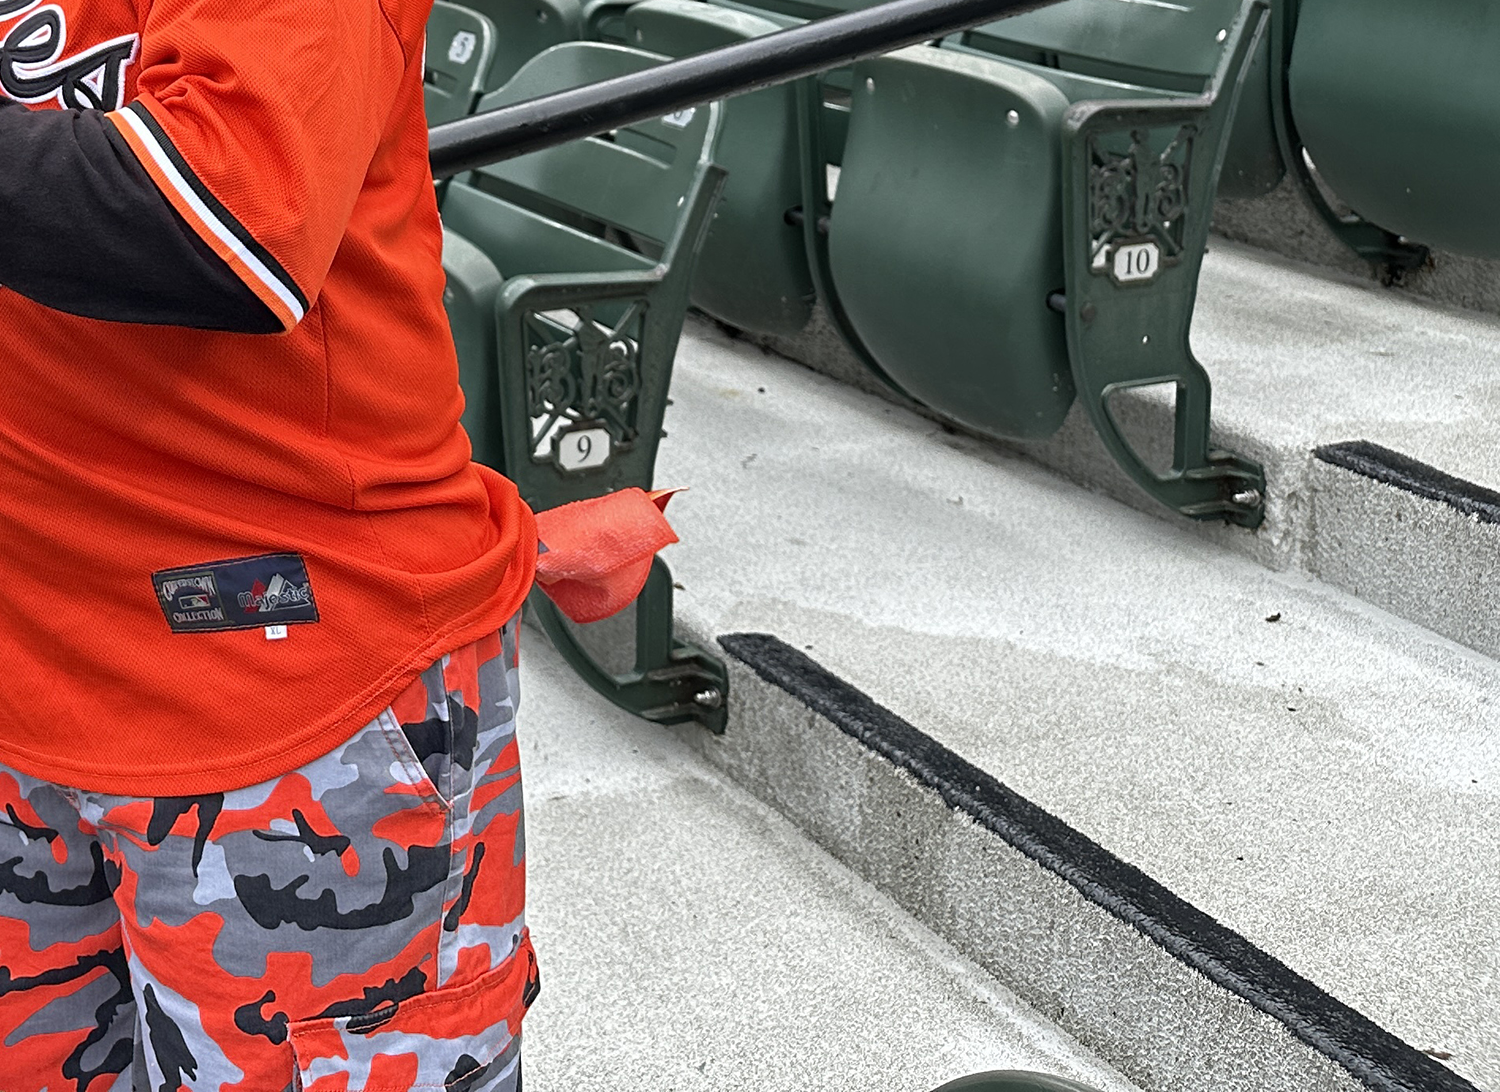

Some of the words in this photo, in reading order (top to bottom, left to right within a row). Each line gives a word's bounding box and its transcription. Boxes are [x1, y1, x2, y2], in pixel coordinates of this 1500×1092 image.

[1125, 249, 1150, 276] 10
[577, 434, 592, 463] 9
[237, 586, 309, 610] Majestic
[172, 607, 224, 624] COLLECTION
[270, 626, 282, 635] XL
